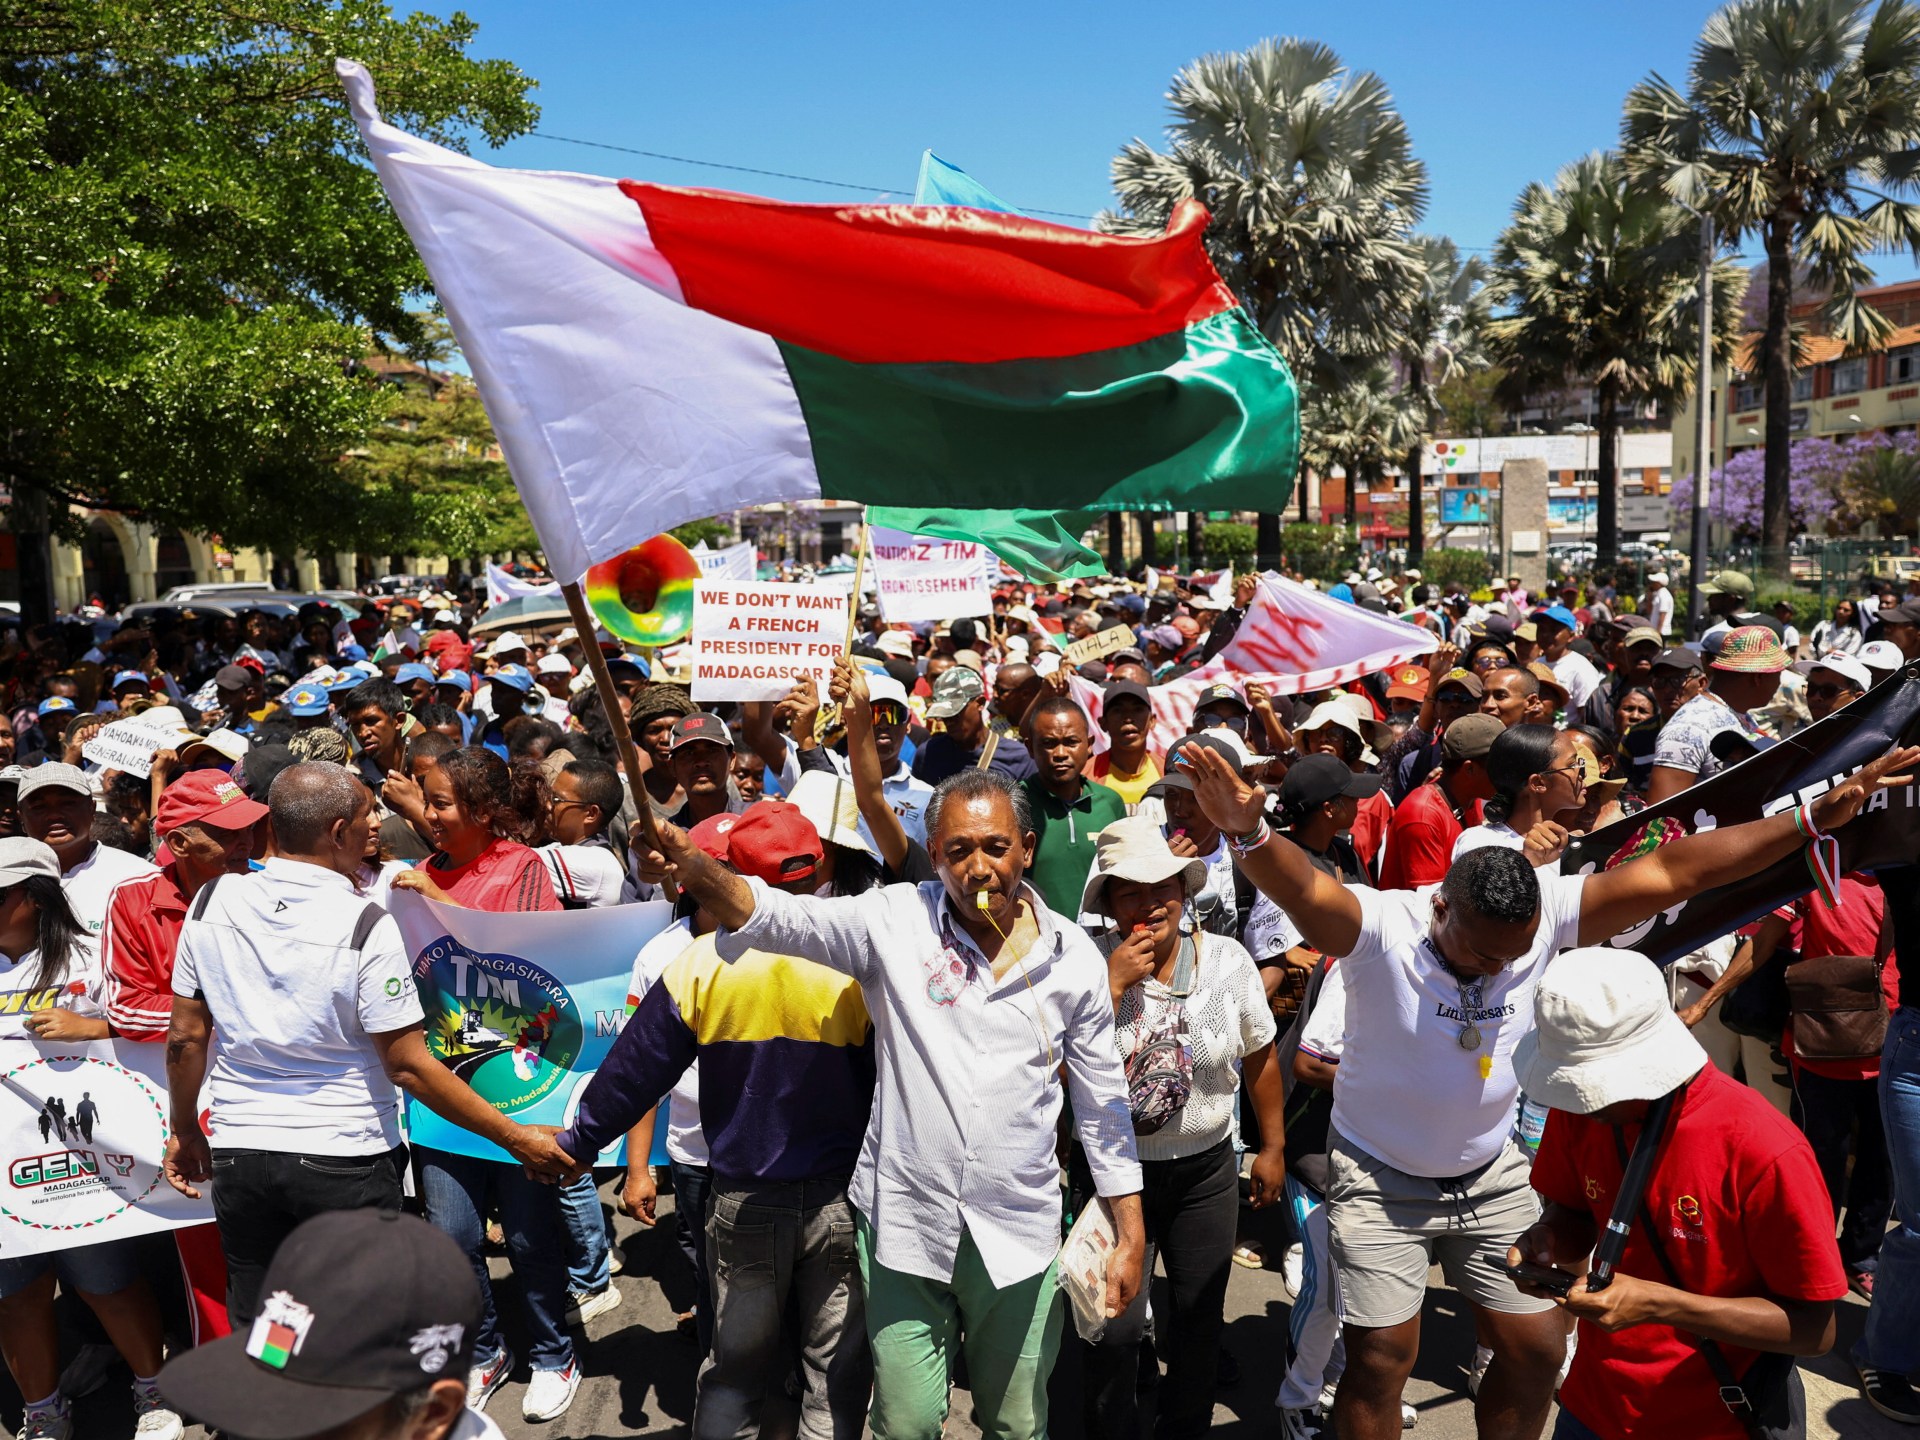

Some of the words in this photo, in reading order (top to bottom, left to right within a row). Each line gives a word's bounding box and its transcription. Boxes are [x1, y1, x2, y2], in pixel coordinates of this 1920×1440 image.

[942, 541, 977, 560] TIM
[701, 591, 729, 605] WE
[735, 592, 791, 608] DON'T
[796, 595, 843, 610] WANT
[728, 617, 741, 630] A
[747, 617, 819, 633] FRENCH
[701, 640, 802, 656] PRESIDENT
[808, 643, 843, 658] FOR
[698, 665, 824, 680] MADAGASCAR
[413, 946, 444, 979] TIAKO
[450, 954, 522, 1009] TIM
[9, 1150, 100, 1189] GEN
[104, 1154, 136, 1178] Y
[43, 1176, 111, 1193] MADAGASCAR
